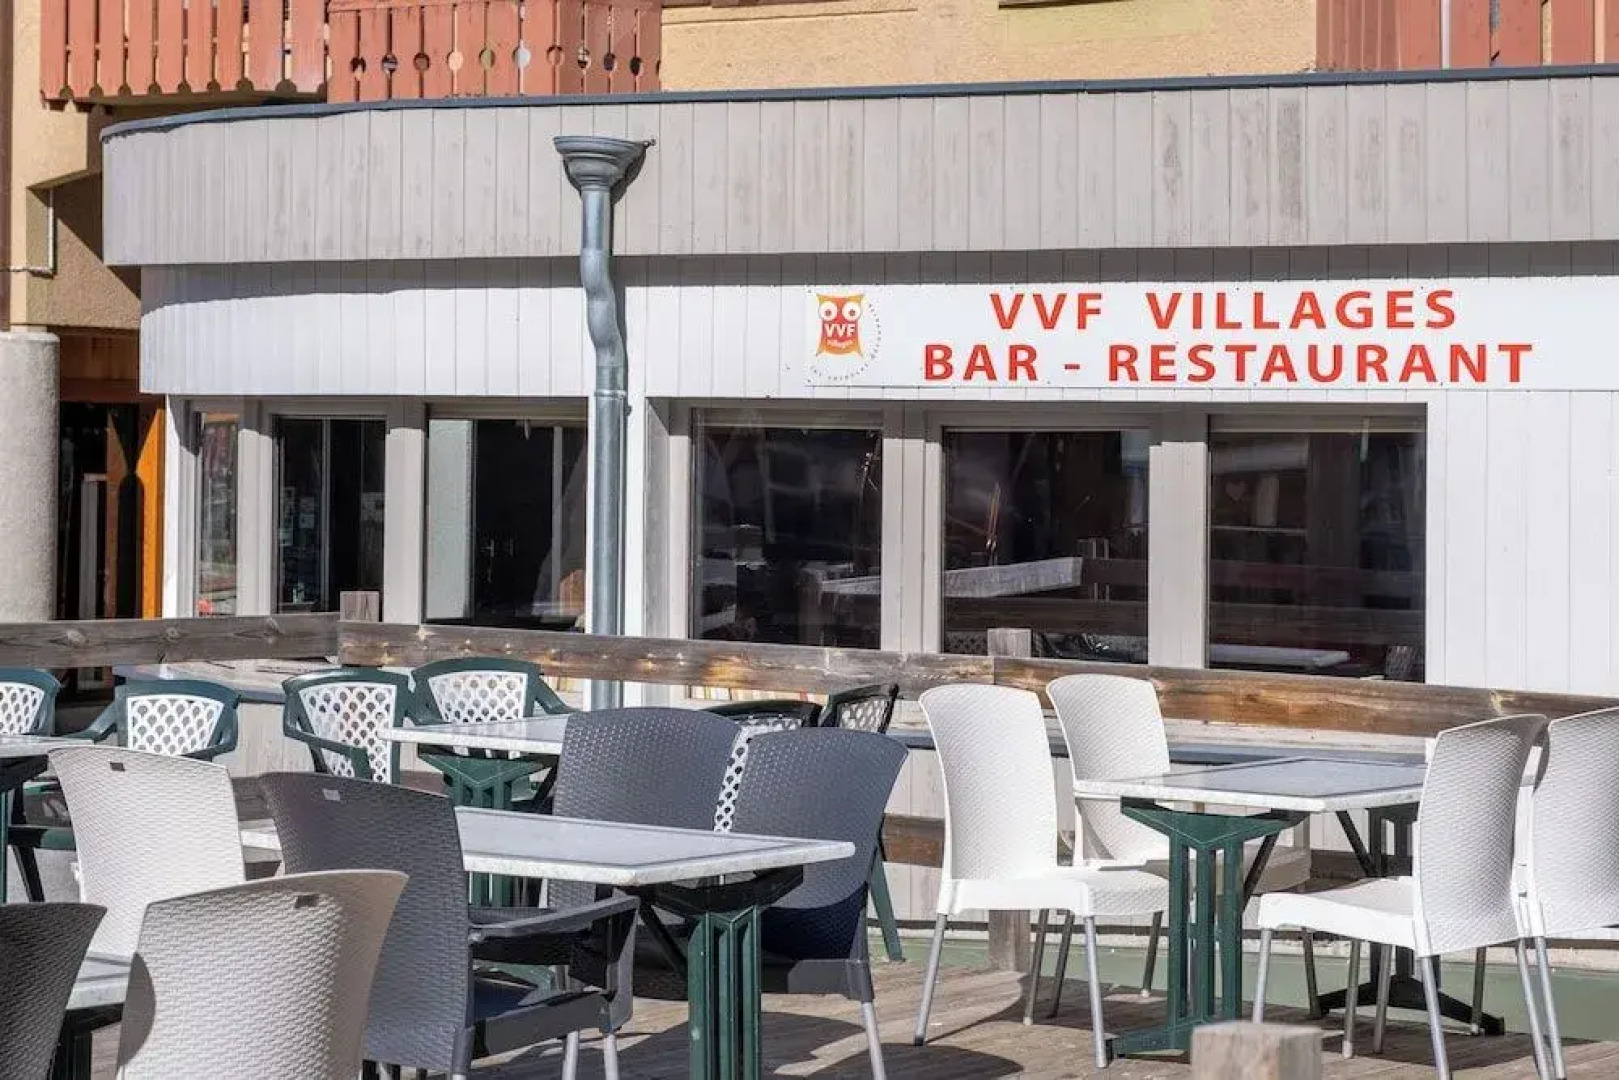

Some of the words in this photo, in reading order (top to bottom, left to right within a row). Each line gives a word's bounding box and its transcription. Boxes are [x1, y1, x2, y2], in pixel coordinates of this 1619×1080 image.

[991, 293, 1103, 330] VVF
[1147, 290, 1456, 330] VILLAGES
[824, 323, 856, 338] VVF
[924, 343, 1037, 381] BAR
[1108, 343, 1531, 382] RESTAURANT
